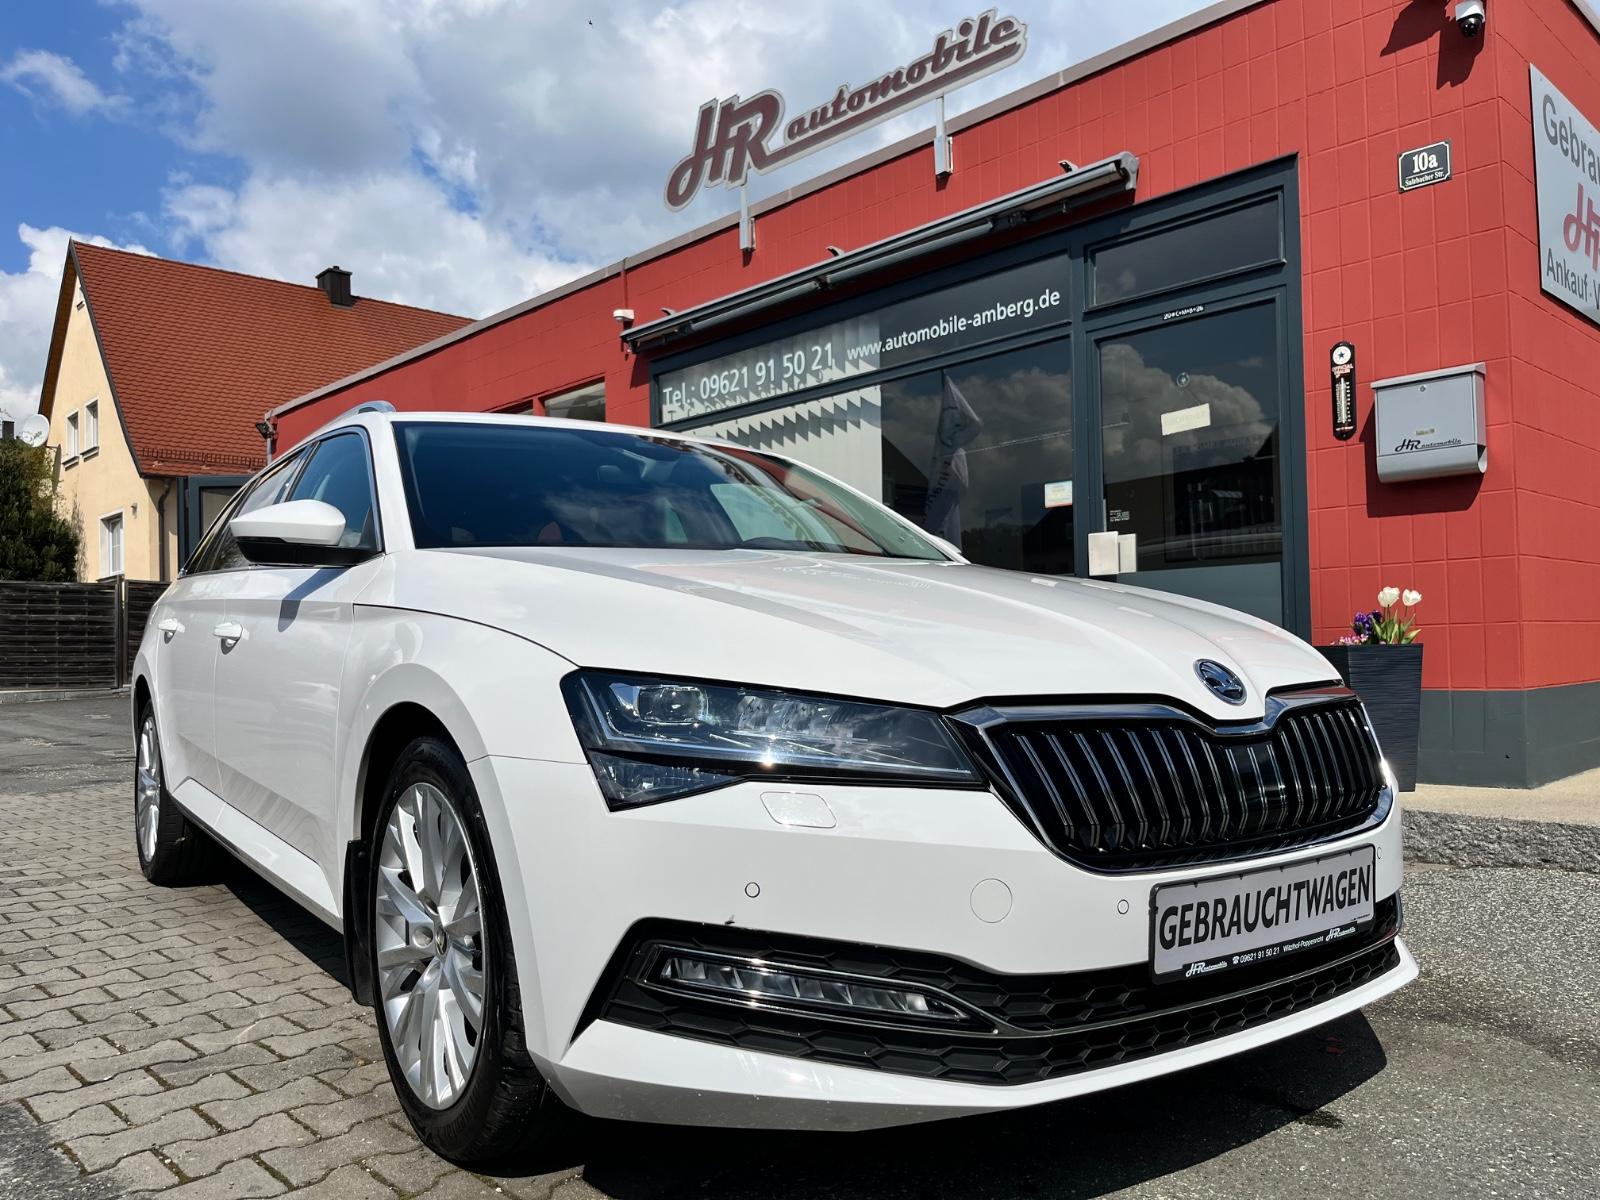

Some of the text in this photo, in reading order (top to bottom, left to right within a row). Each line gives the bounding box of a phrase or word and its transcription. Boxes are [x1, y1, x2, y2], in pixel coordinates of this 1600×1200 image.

[665, 12, 1022, 209] HR automobile
[1412, 151, 1438, 174] 10a
[1434, 170, 1445, 180] Str.
[1546, 247, 1588, 303] Ankauf
[846, 288, 1061, 361] www.automobile-amberg.de
[699, 365, 749, 400] 09621
[755, 357, 776, 387] 91
[782, 350, 806, 379] 50
[811, 341, 833, 372] 21
[1394, 438, 1421, 452] HR
[1158, 864, 1371, 951] GEBRAUCHTWAGEN
[1239, 951, 1257, 964] 09621
[1257, 949, 1265, 960] 91
[1265, 947, 1273, 958] 50
[1273, 946, 1280, 956] 21
